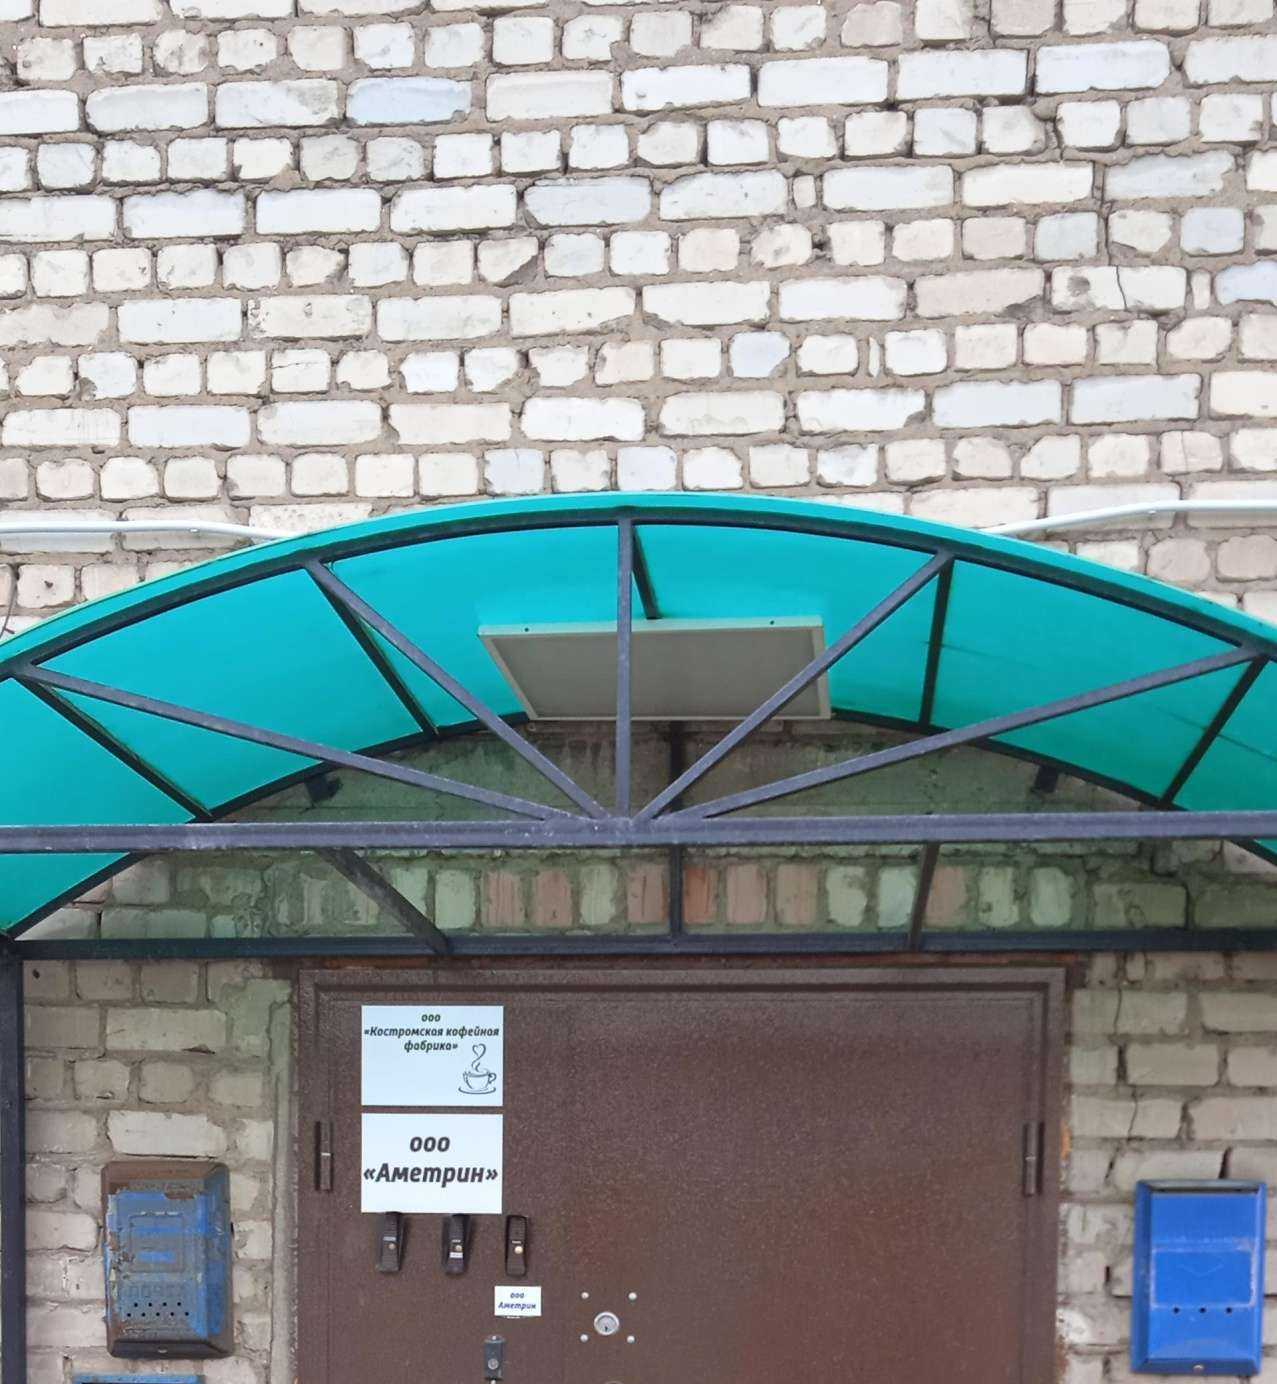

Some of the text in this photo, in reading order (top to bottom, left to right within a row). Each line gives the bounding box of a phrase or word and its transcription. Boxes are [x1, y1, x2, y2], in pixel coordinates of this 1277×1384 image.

[364, 1026, 499, 1039] «Костромская кофейная
[404, 1040, 458, 1053] фабрика»
[364, 1163, 498, 1188] «Аметрин»
[498, 1302, 536, 1311] Аметрин
